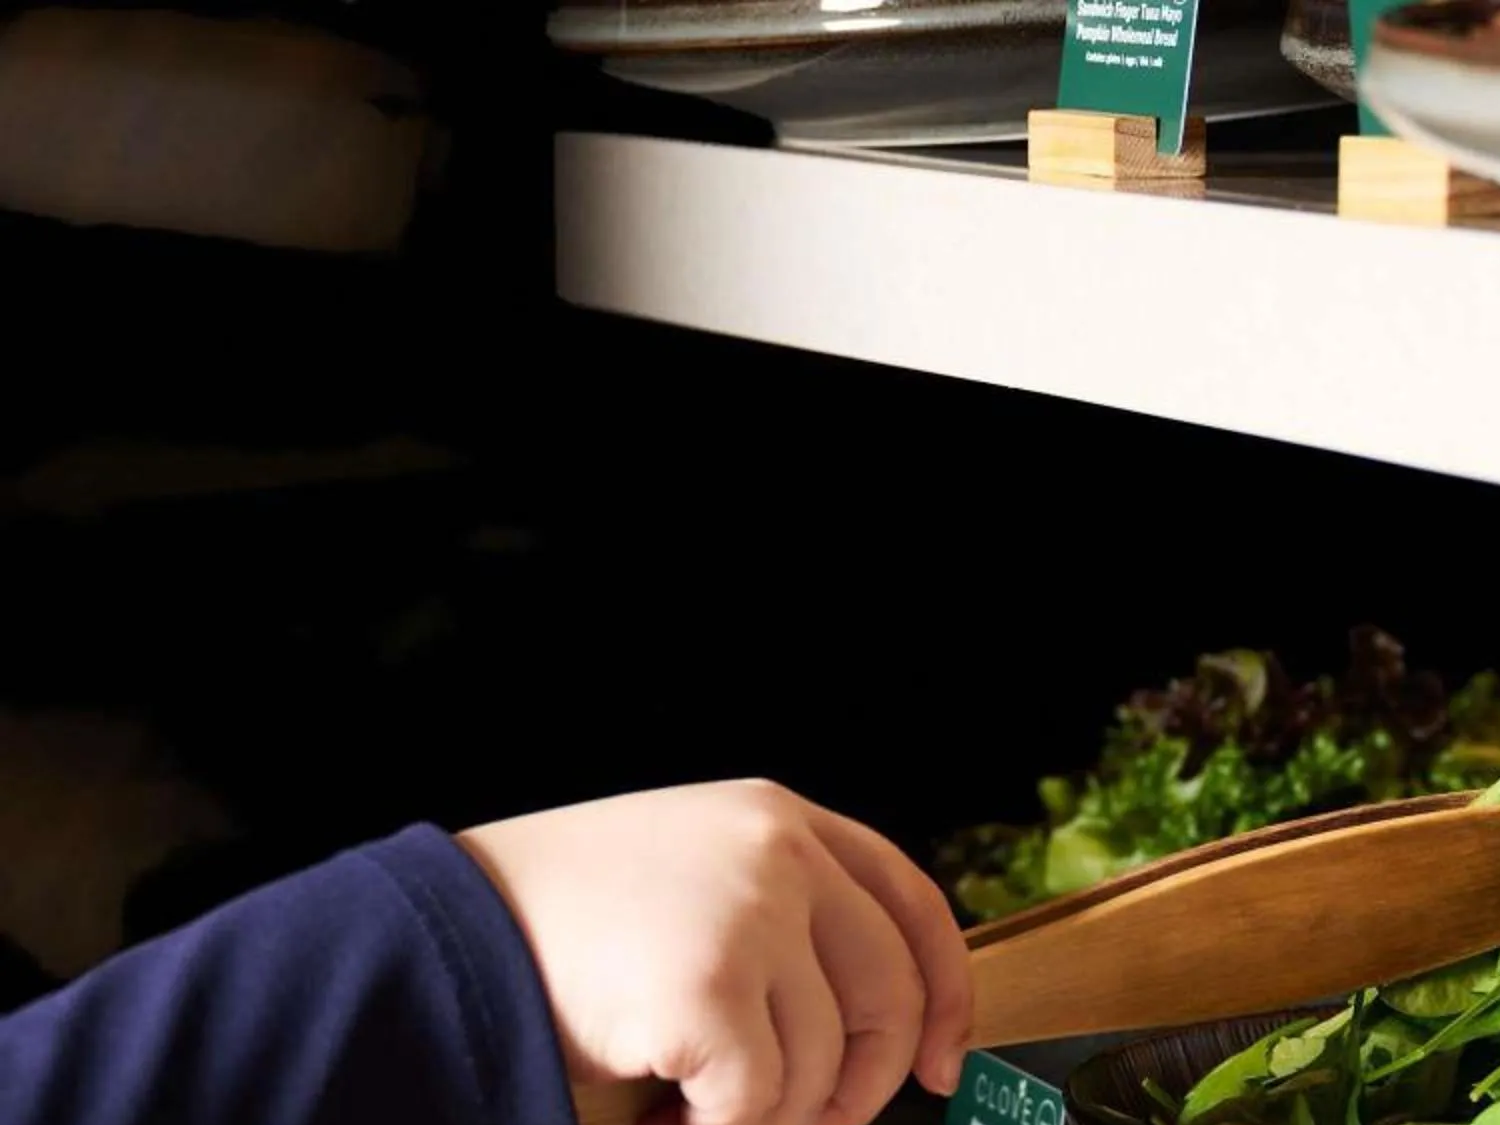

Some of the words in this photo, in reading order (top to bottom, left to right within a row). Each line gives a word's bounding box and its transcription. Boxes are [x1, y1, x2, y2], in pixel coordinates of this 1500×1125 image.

[1115, 1, 1140, 23] Finger
[1141, 4, 1160, 21] Tuna
[1162, 5, 1183, 25] Mayo
[1076, 23, 1111, 43] Pumpkin
